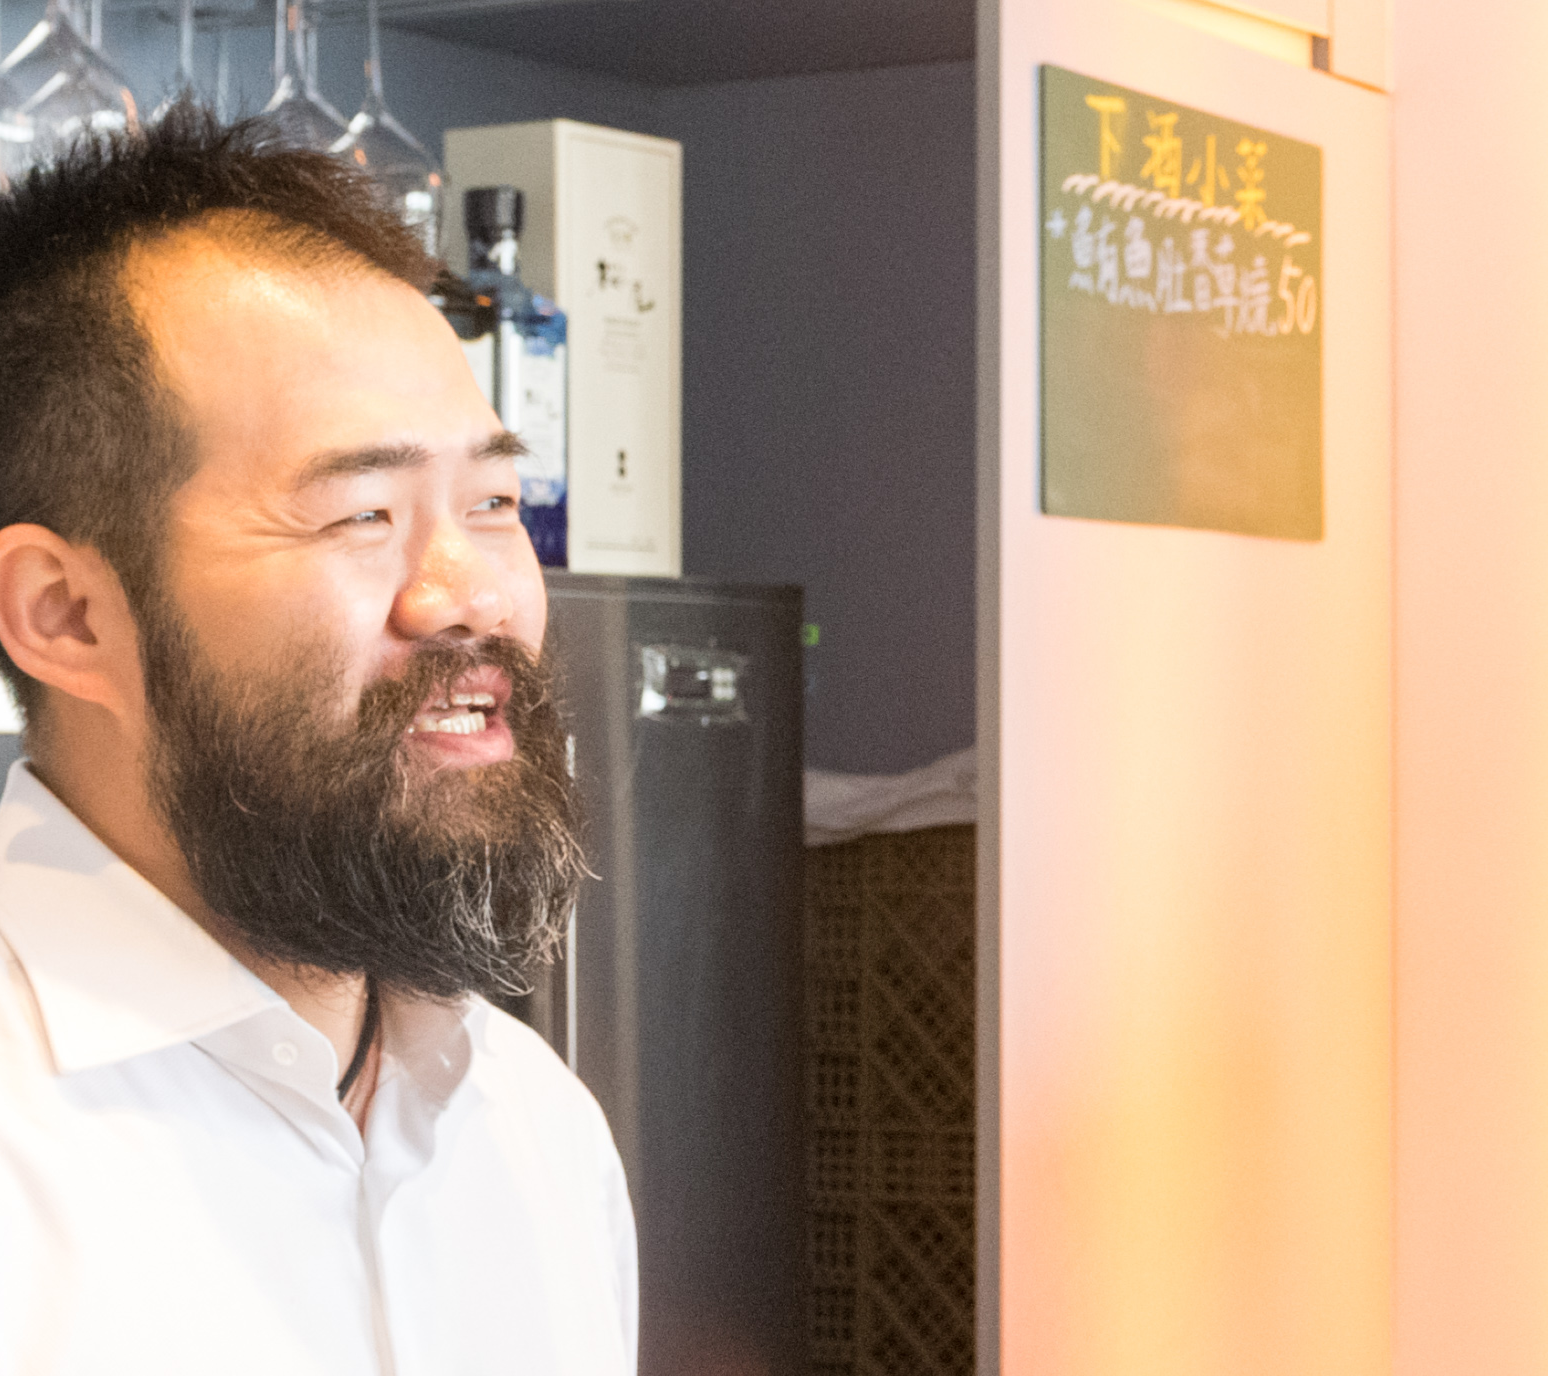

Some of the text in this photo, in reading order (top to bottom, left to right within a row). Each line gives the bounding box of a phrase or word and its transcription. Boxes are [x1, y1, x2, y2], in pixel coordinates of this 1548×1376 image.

[1084, 94, 1268, 231] 下酒小菜
[1278, 255, 1318, 334] 50
